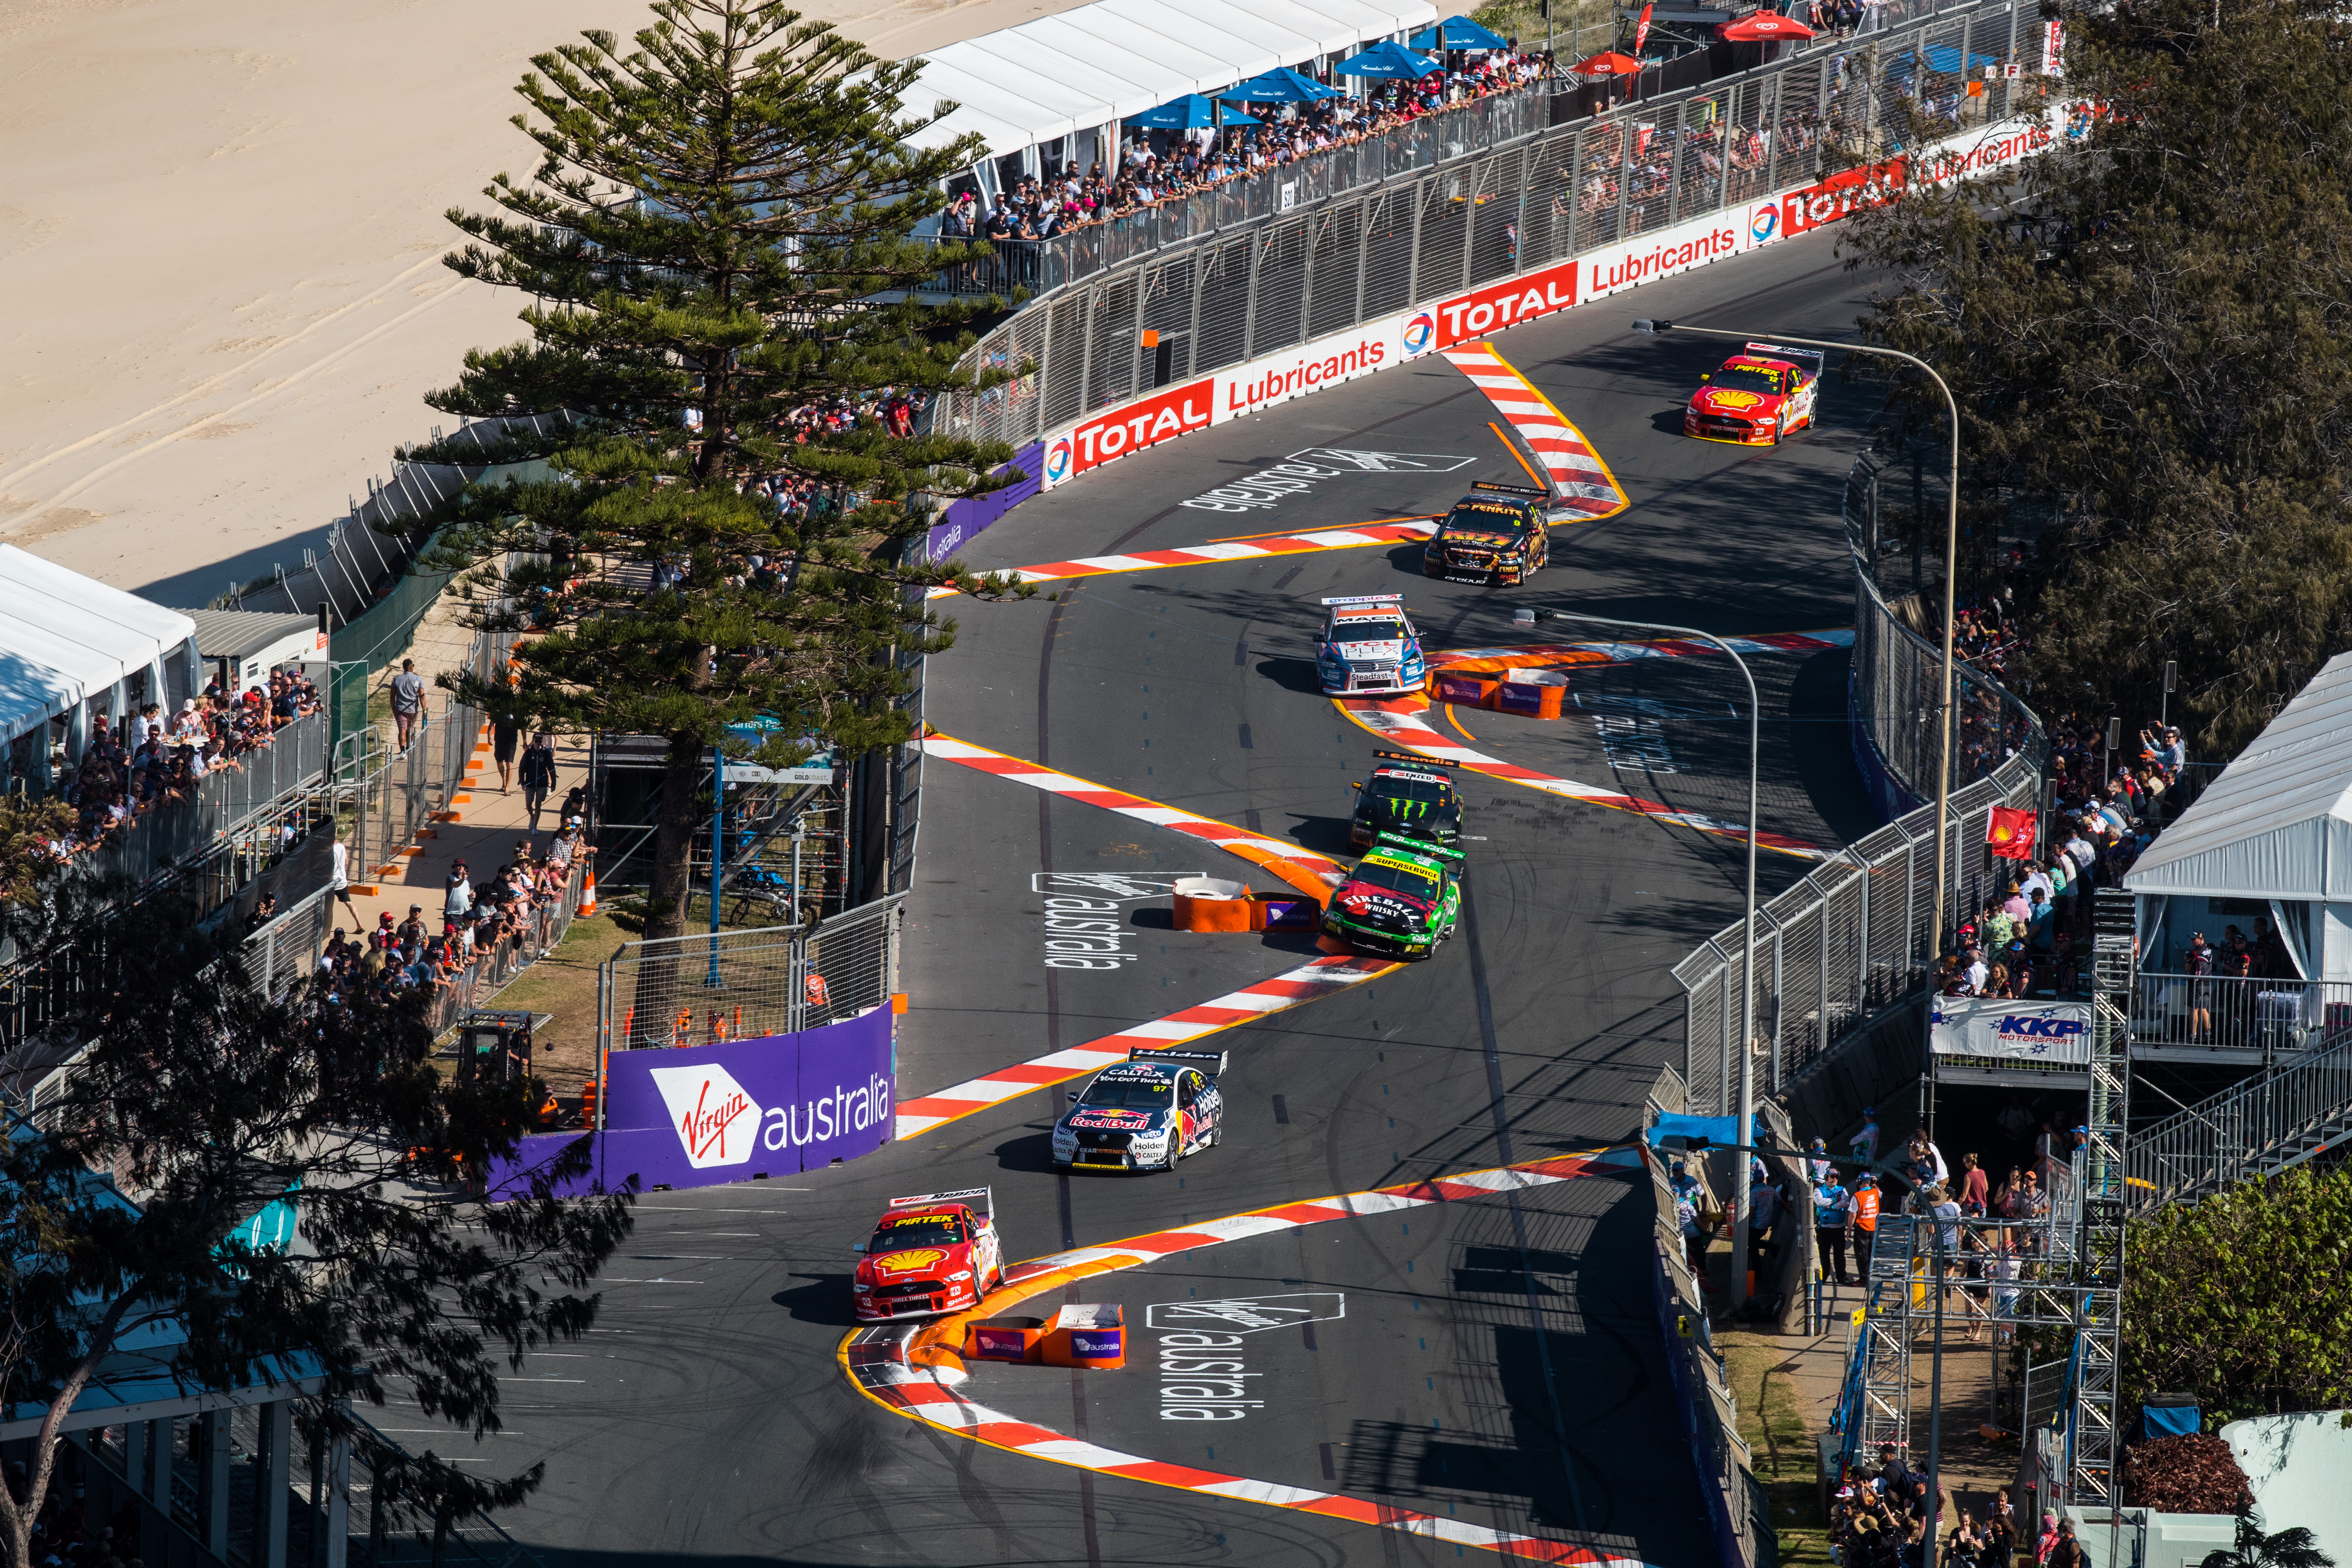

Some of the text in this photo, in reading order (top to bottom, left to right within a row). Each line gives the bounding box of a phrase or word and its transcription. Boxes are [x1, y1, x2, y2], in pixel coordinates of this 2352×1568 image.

[2008, 66, 2017, 77] F
[1284, 190, 1292, 208] S20
[1442, 228, 1735, 337] TOTAL Lubricants
[1734, 365, 1781, 377] PIRTEK
[1078, 341, 1384, 462] TOTAL Lubricants
[1178, 465, 1341, 512] australia
[1471, 504, 1522, 517] PENRITE
[1441, 530, 1513, 546] KISS
[1346, 646, 1398, 655] PLEX
[1455, 690, 1479, 698] australia
[1514, 694, 1538, 702] australia
[1390, 753, 1454, 766] Scandia
[1376, 858, 1438, 879] SUPERSERVICE
[1365, 903, 1399, 917] WHISKY
[1044, 898, 1137, 970] australia
[1999, 1015, 2084, 1038] KKP
[1998, 1034, 2076, 1045] MOTORSPORT
[1136, 1050, 1219, 1059] Holden
[1109, 1069, 1165, 1078] CALTEX
[1196, 1089, 1221, 1117] Holden
[682, 1072, 889, 1159] Virgin australia
[1069, 1117, 1149, 1131] Red Bull
[1141, 1130, 1161, 1139] IVECO
[1054, 1137, 1074, 1146] Holden
[895, 1215, 955, 1227] PIRTEK
[951, 1286, 961, 1295] PPG
[947, 1292, 972, 1307] SHARP
[995, 1343, 1021, 1351] australia
[1090, 1342, 1120, 1351] australia
[1160, 1334, 1265, 1420] australia
